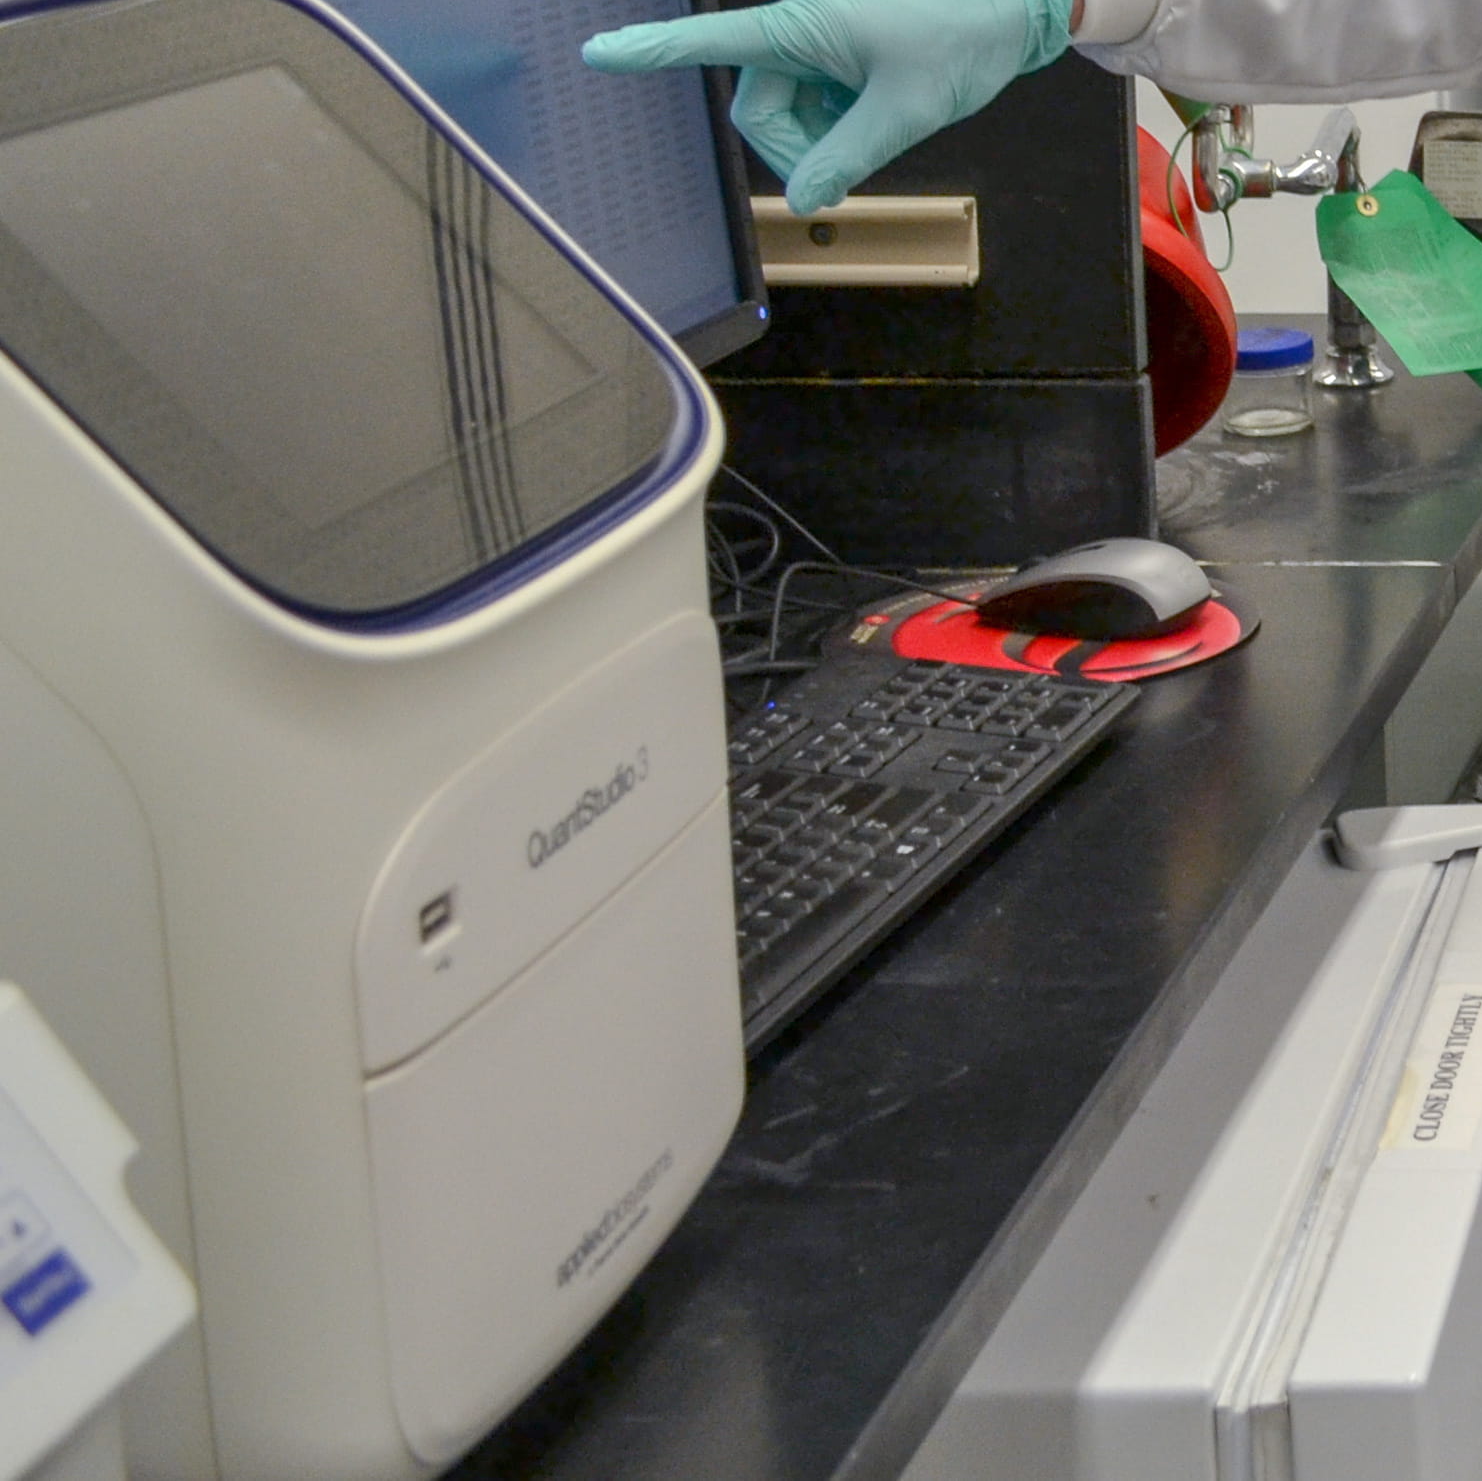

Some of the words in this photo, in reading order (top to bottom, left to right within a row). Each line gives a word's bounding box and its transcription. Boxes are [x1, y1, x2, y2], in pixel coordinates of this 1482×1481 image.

[527, 763, 635, 868] QuantStudio
[636, 744, 649, 782] 3
[1430, 1050, 1465, 1090] DOOR
[1413, 1093, 1450, 1142] CLOSE
